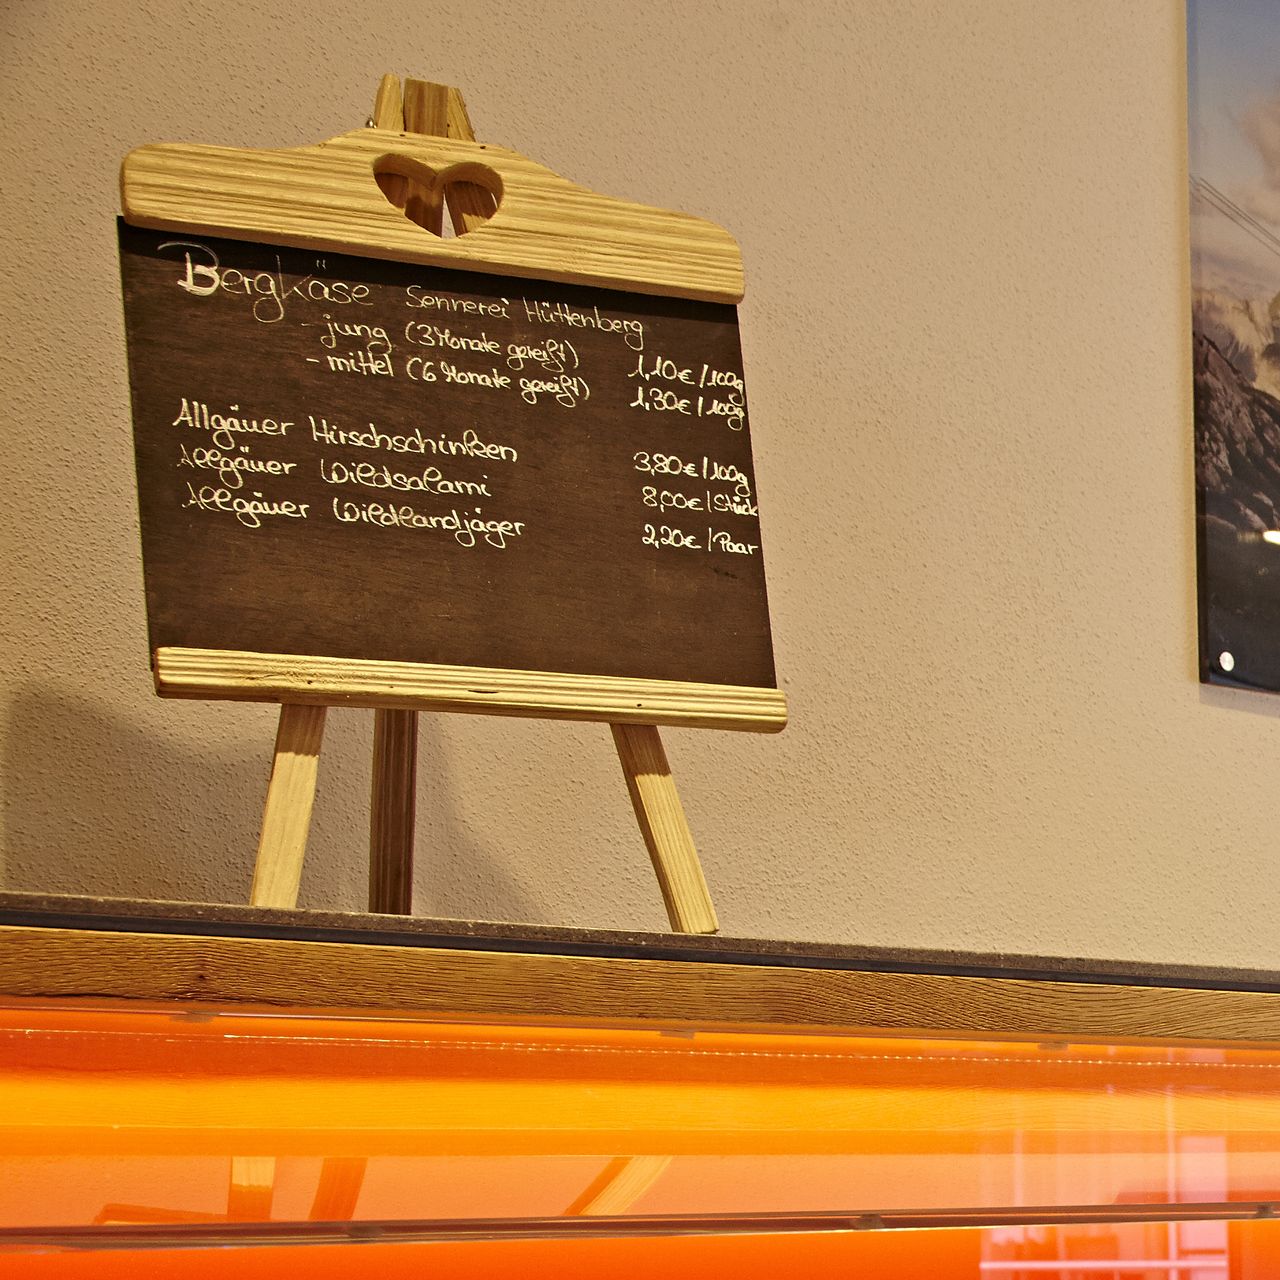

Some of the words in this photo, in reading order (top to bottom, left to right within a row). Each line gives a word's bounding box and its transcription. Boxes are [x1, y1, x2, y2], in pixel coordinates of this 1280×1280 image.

[522, 296, 643, 351] Hüttenberg
[172, 398, 296, 450] Allgäuer
[308, 415, 518, 463] Hirschschinken
[176, 443, 298, 489] Allgäuer
[320, 458, 492, 497] Wildsalami
[182, 481, 310, 529] Allgäuer
[332, 497, 525, 549] Wildlandjäger
